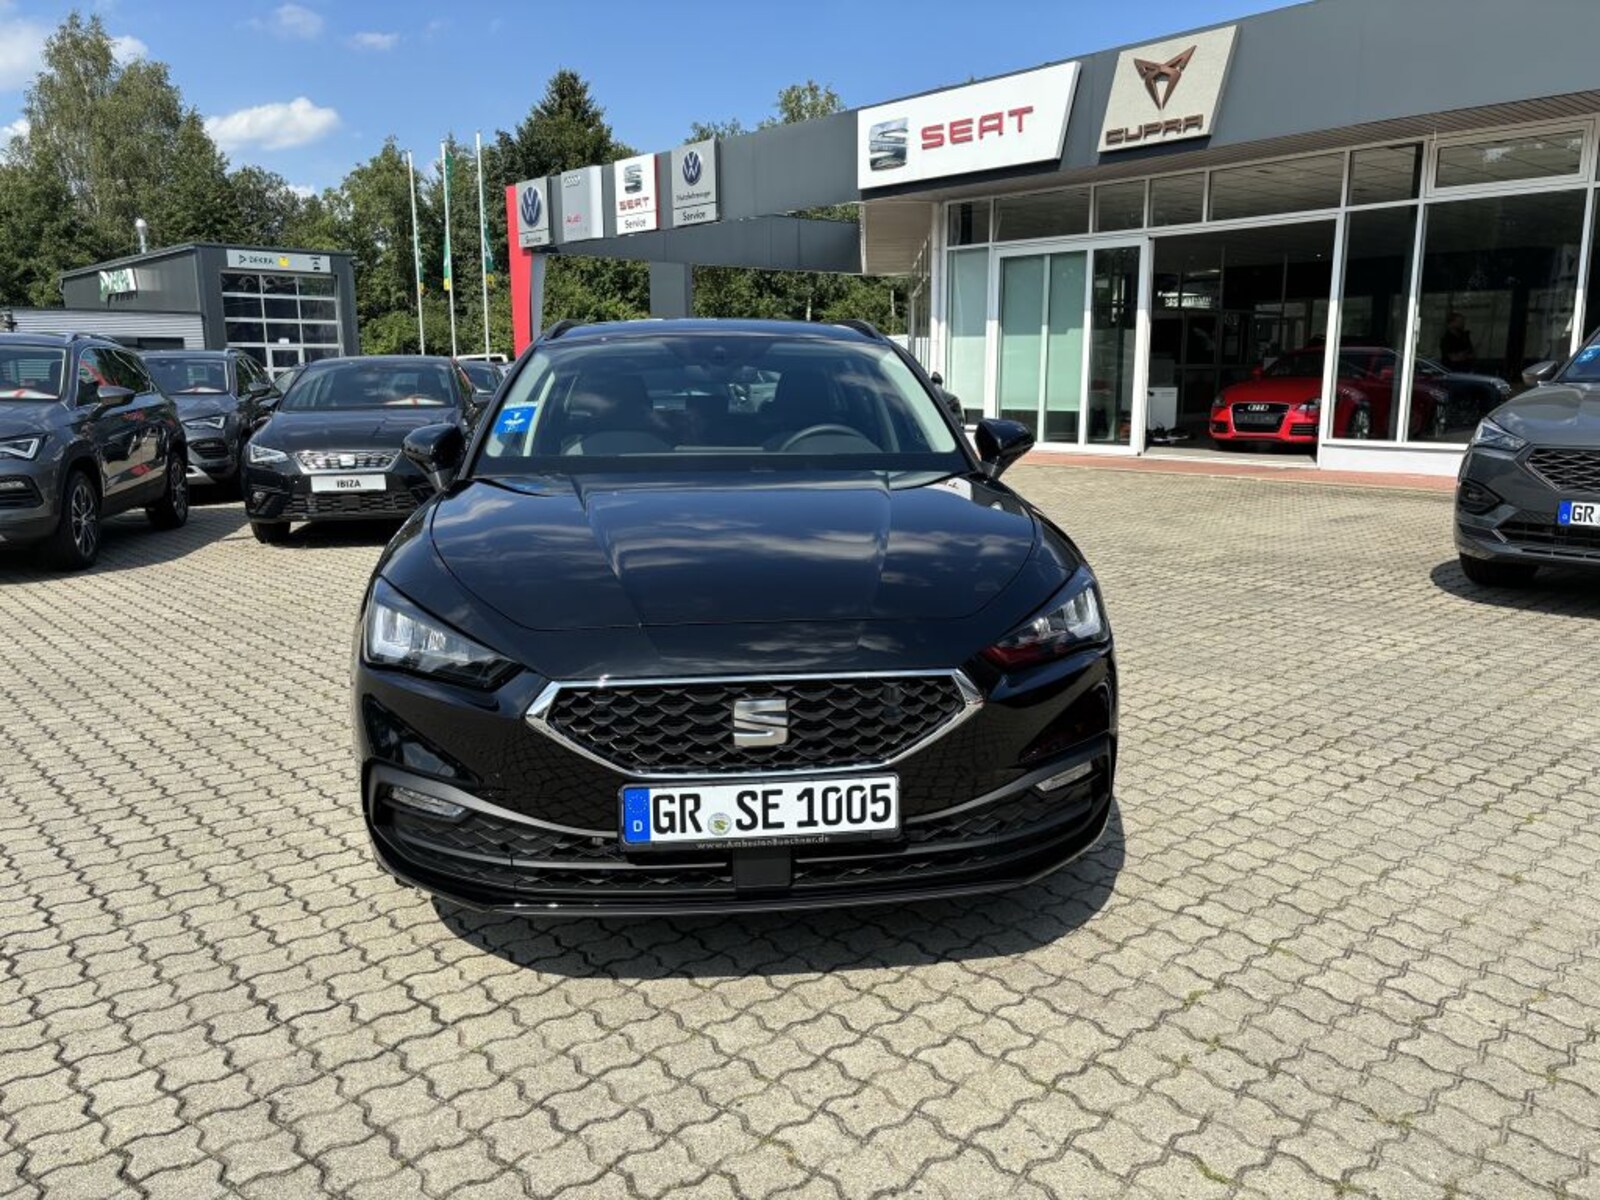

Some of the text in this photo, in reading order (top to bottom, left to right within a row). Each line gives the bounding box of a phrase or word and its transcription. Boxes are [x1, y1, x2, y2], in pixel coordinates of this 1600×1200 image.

[920, 105, 1034, 151] SEAT
[1105, 113, 1204, 146] CUPRA
[618, 196, 650, 212] SEAT
[624, 217, 647, 229] Service
[682, 210, 706, 221] Service
[336, 479, 362, 489] IBIZA
[1572, 504, 1595, 523] GR
[632, 783, 892, 835] D GR SE 1005
